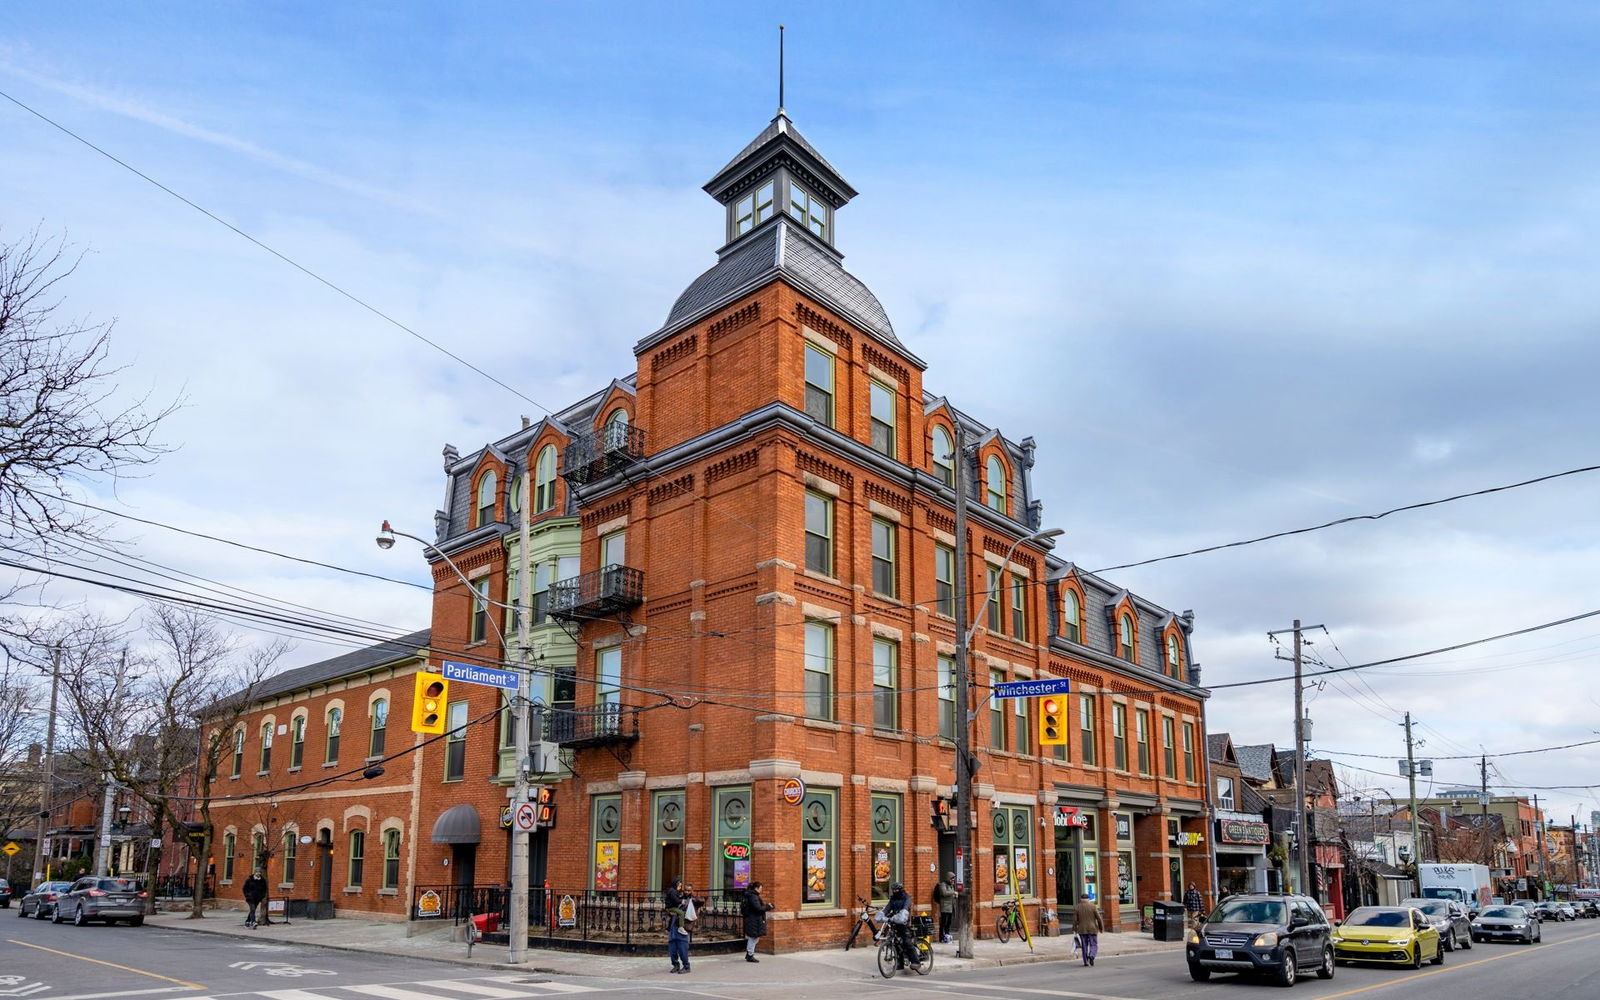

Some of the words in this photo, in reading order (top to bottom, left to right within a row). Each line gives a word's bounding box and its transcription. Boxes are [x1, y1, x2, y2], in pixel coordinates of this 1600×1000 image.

[447, 664, 507, 686] Parliament
[997, 683, 1057, 697] Winchester
[1176, 832, 1202, 846] SUBWAY
[726, 845, 748, 858] OPEN
